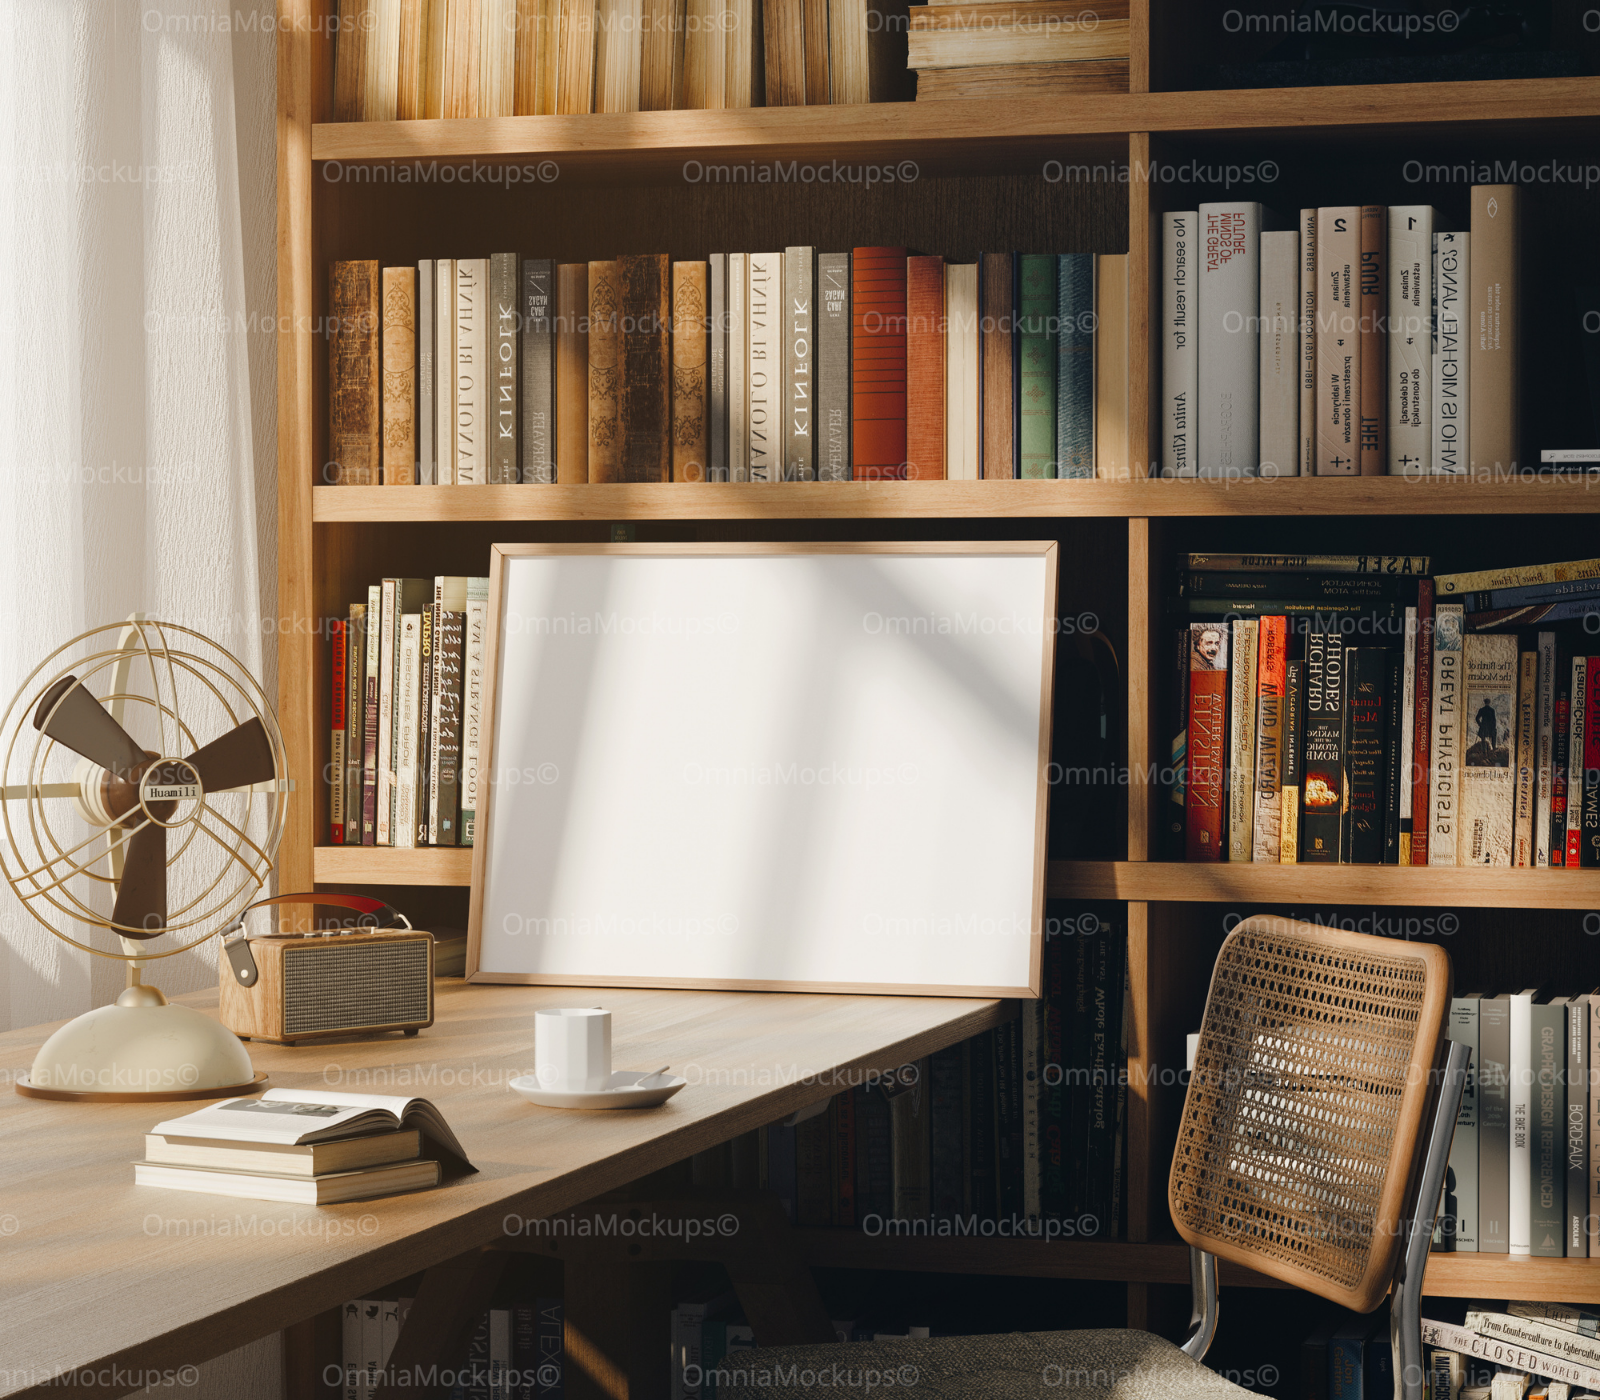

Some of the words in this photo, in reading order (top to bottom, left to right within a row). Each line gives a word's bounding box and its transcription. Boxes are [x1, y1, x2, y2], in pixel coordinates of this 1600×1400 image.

[150, 787, 196, 797] Huamili
[1540, 1027, 1554, 1080] GRAPHIC
[1515, 1104, 1526, 1114] THE
[1540, 1083, 1554, 1126] DESIGN
[1515, 1118, 1526, 1130] BIKE
[1515, 1133, 1526, 1148] BOOK
[1569, 1104, 1583, 1170] BORDEAUX
[1540, 1131, 1554, 1208] REFERENCED
[1483, 1318, 1501, 1332] From
[1502, 1323, 1553, 1348] Counterculture
[1554, 1339, 1562, 1349] to
[1333, 1346, 1344, 1397] Gertner
[1344, 1359, 1355, 1384] Jon
[1454, 1337, 1468, 1347] THE
[1472, 1339, 1537, 1370] CLOSED
[1542, 1363, 1579, 1380] WORLD
